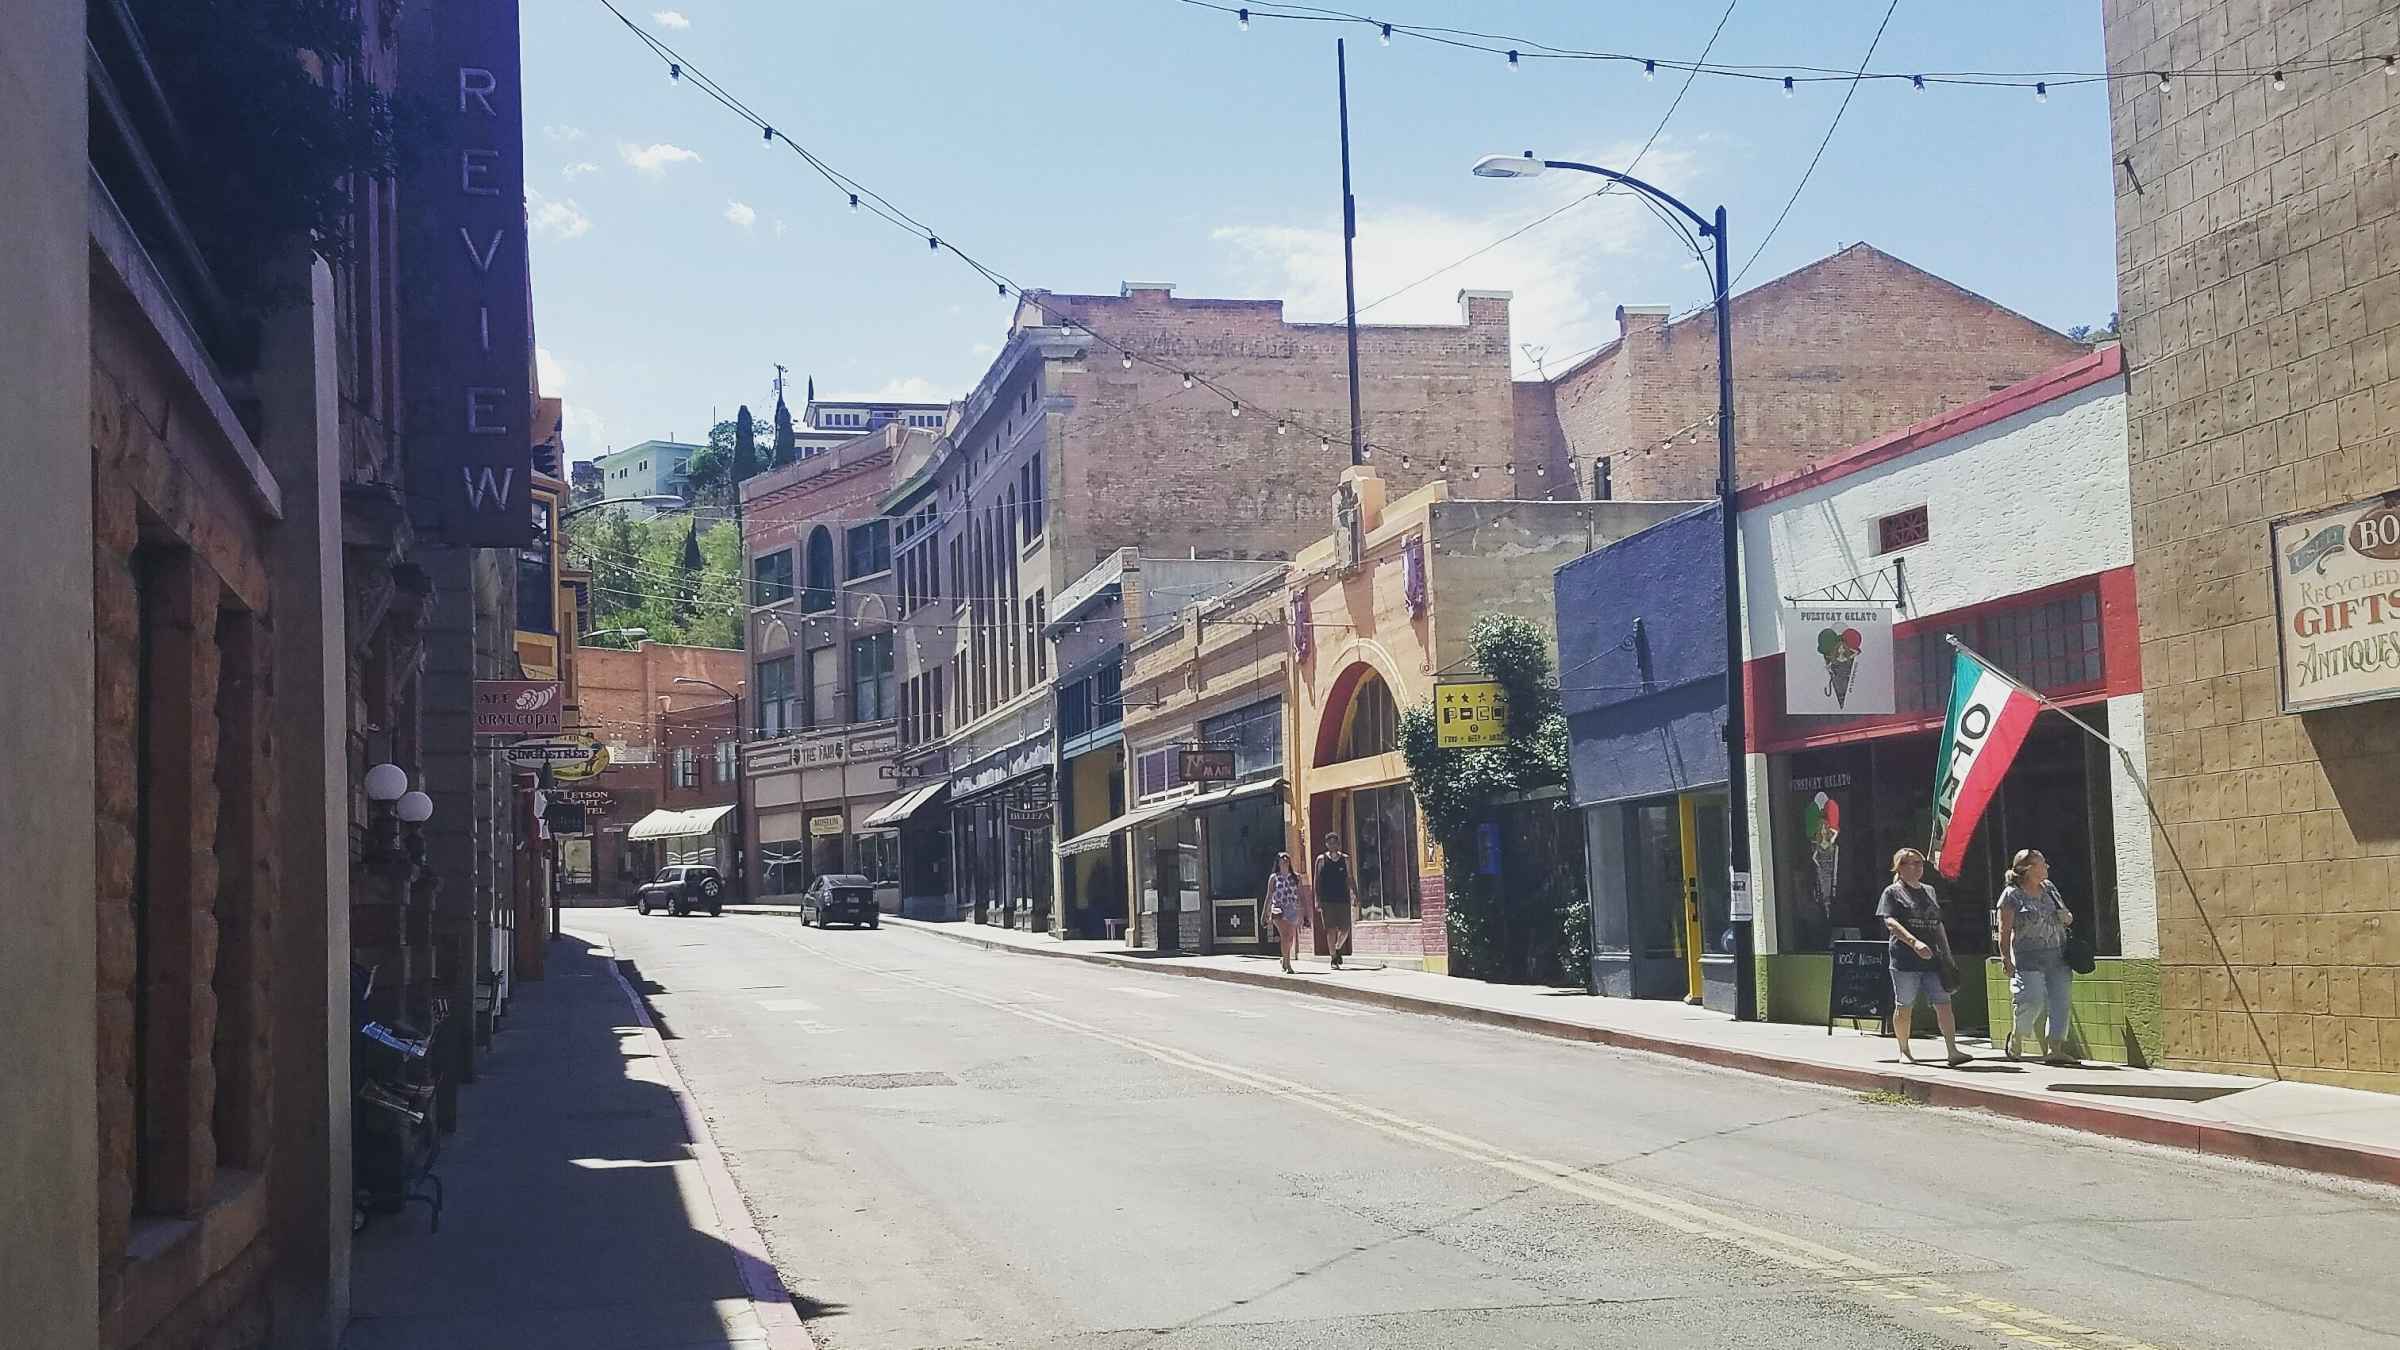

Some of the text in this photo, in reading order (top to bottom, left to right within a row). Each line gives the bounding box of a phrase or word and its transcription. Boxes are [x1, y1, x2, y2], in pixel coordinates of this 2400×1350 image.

[458, 66, 514, 512] REVIEW
[2358, 513, 2400, 551] BO
[2299, 569, 2400, 606] RECYCLED
[1845, 611, 1877, 621] GELATO
[2296, 630, 2400, 688] ANTIQUES
[478, 712, 558, 729] ORNUCOPIA
[586, 807, 606, 815] TEL
